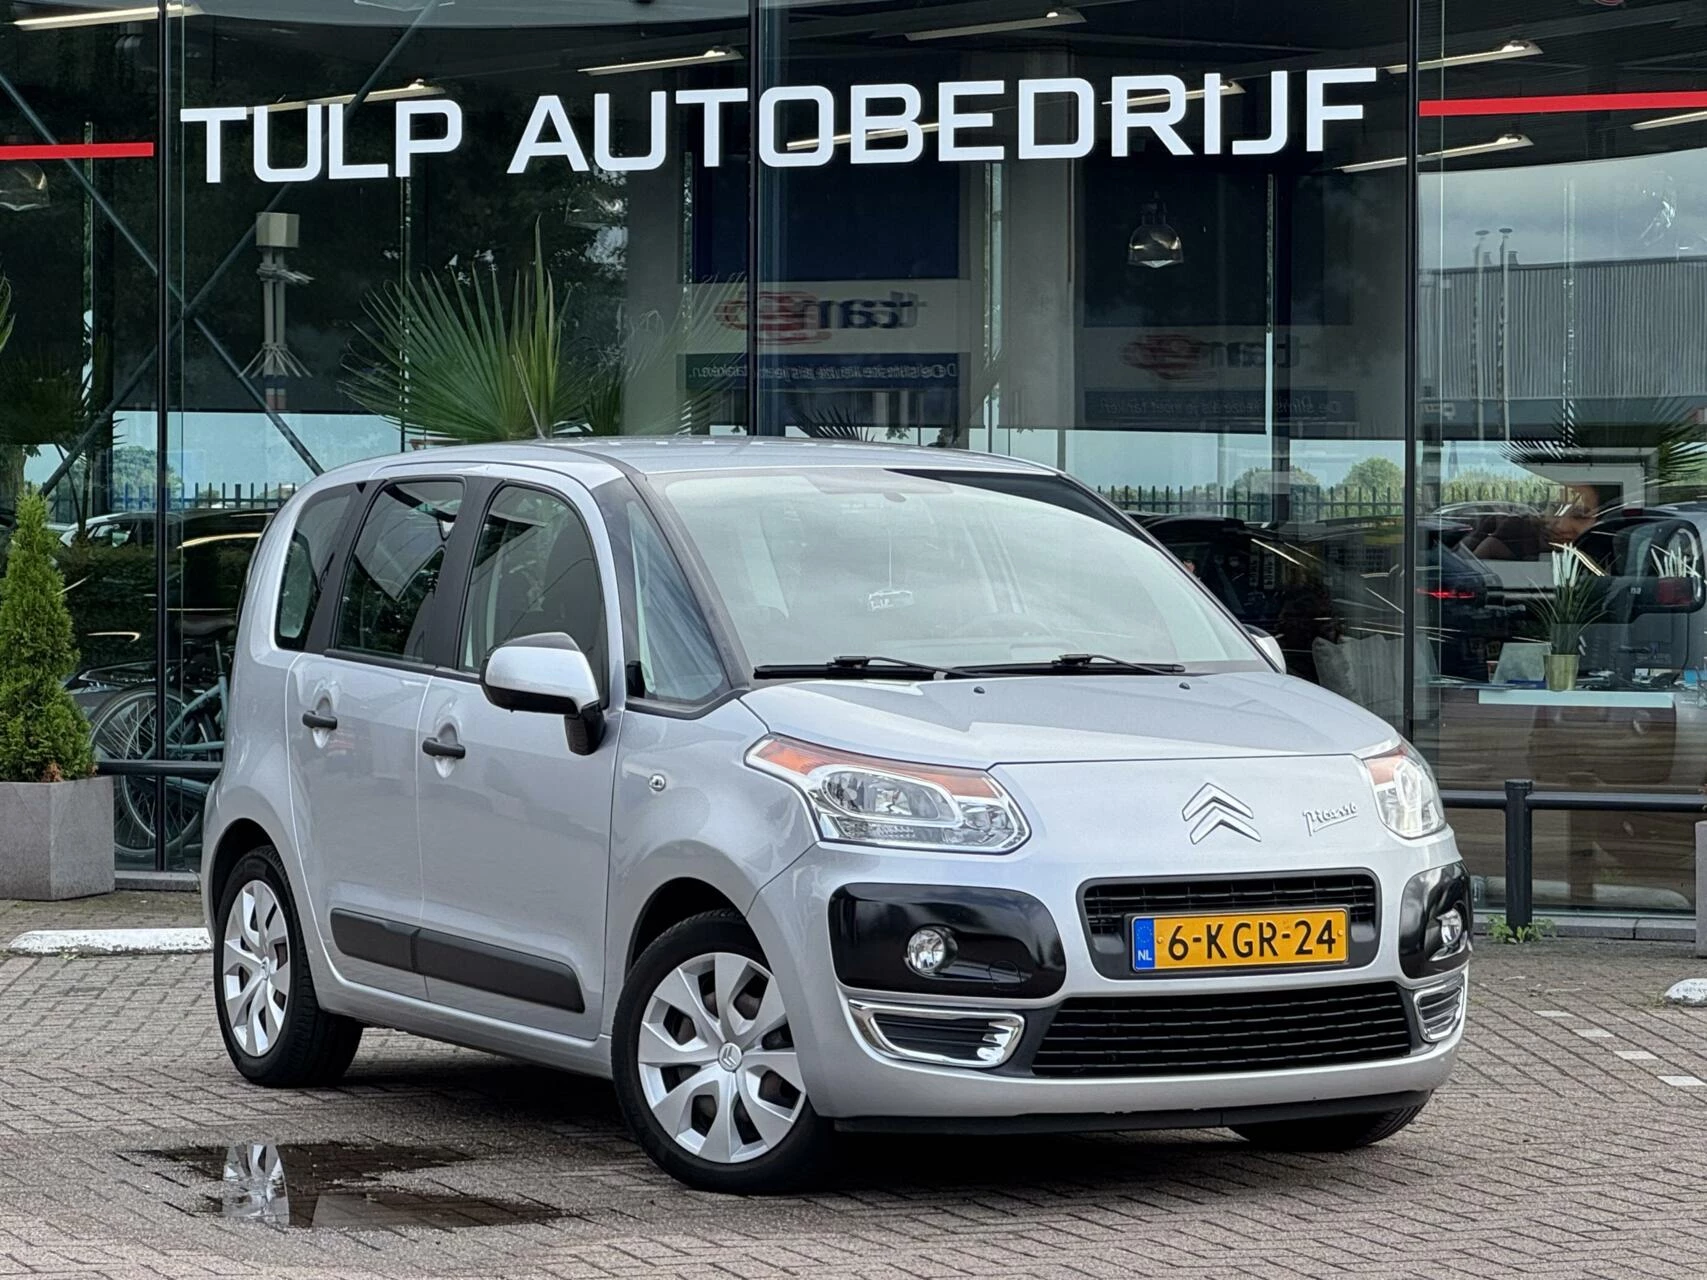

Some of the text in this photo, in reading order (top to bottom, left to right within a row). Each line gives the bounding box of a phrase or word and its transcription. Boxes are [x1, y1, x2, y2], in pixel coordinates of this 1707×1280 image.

[180, 67, 1377, 183] TULP AUTOBEDRIJF
[1137, 949, 1153, 961] NL
[1168, 919, 1336, 961] 6-KGR-24
